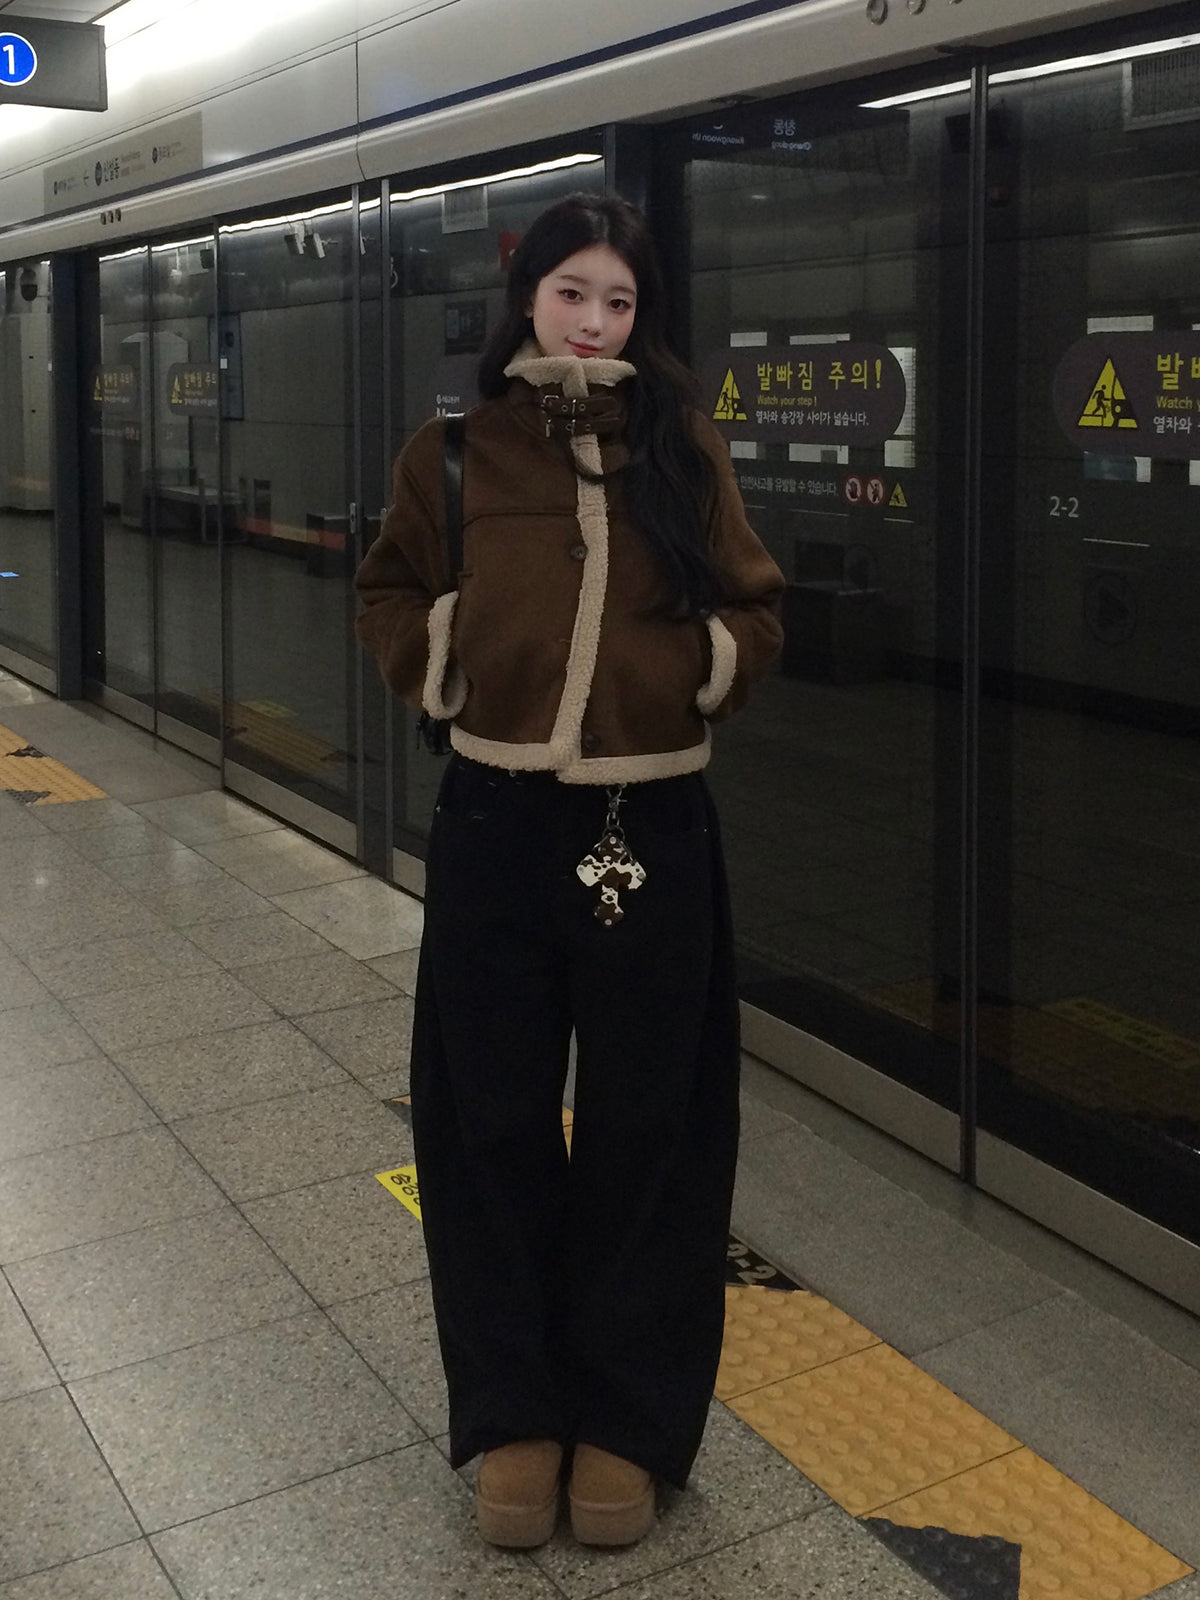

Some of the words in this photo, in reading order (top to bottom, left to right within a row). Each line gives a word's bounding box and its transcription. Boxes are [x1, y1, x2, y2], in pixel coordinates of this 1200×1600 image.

[3, 44, 15, 75] 1
[757, 361, 813, 391] 발빠짐
[828, 359, 882, 390] 주의!
[757, 395, 779, 405] Watch
[780, 397, 795, 407] your
[1156, 395, 1193, 410] Watch
[755, 410, 779, 424] 열차와
[781, 410, 804, 425] 승강장
[807, 411, 831, 425] 사이가
[833, 412, 869, 427] 넓습니다.
[1153, 416, 1192, 434] 열차와
[797, 479, 806, 493] 수
[807, 480, 838, 496] 있습니다.
[1049, 496, 1079, 518] 2-2
